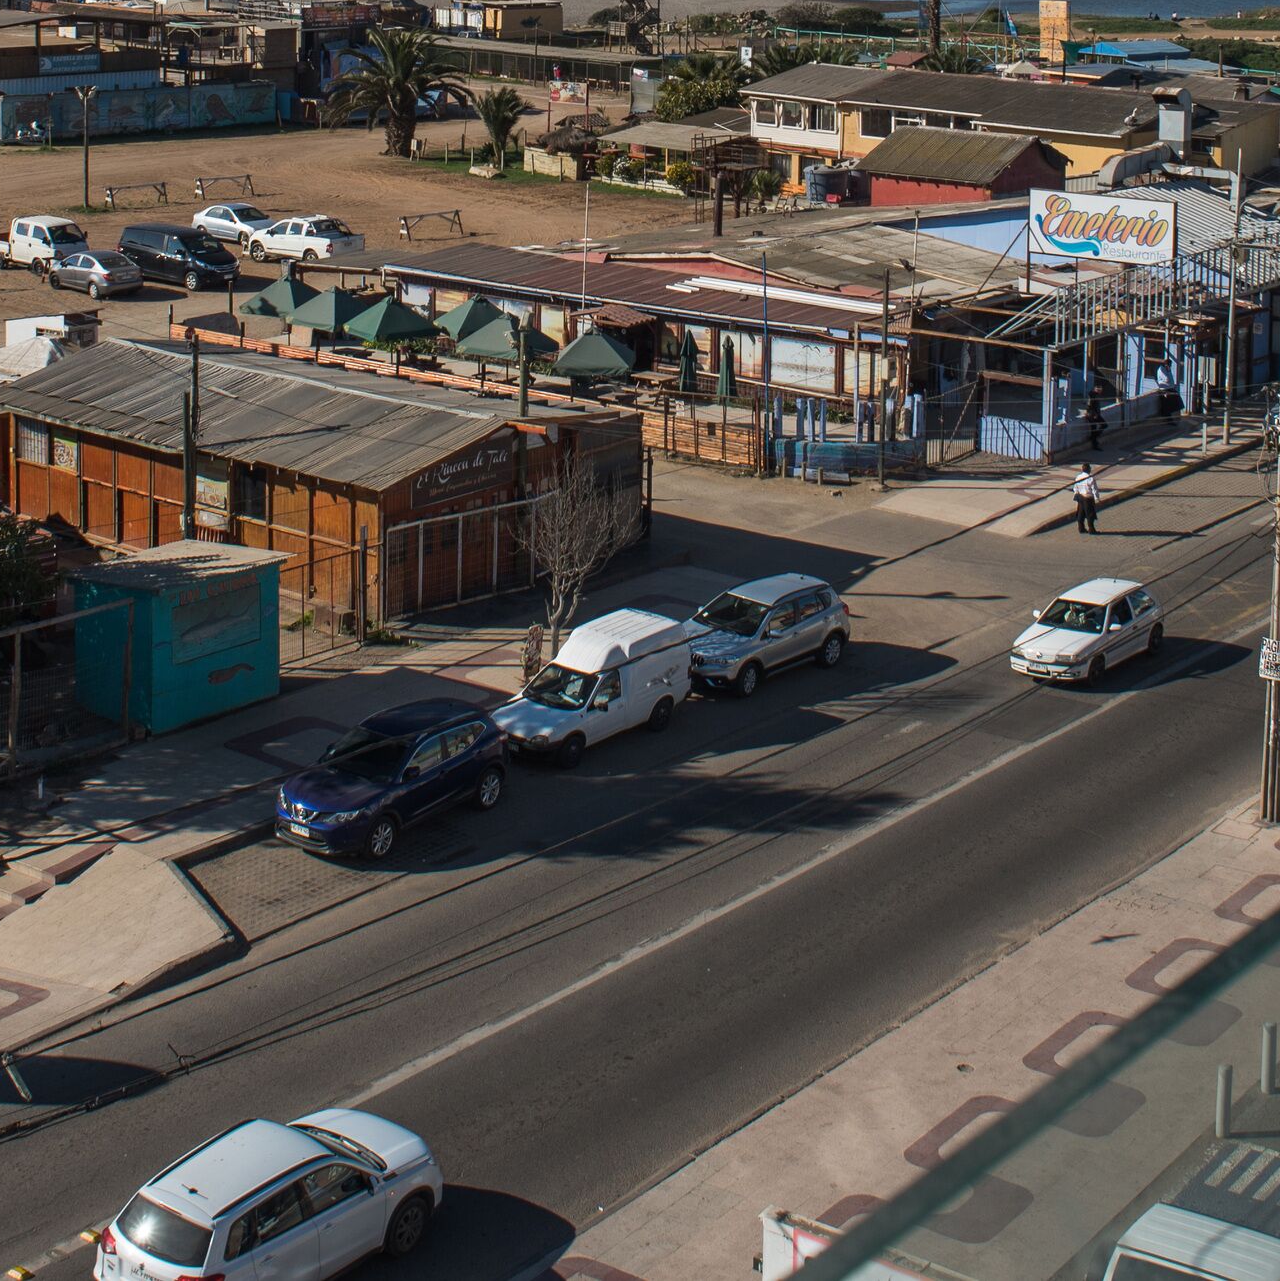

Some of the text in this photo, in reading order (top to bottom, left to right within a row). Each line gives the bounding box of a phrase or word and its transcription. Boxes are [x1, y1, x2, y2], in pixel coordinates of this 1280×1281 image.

[1042, 194, 1169, 247] Emeterio
[1103, 244, 1167, 262] Restaurante
[472, 450, 483, 467] de
[1260, 651, 1277, 662] WEB
